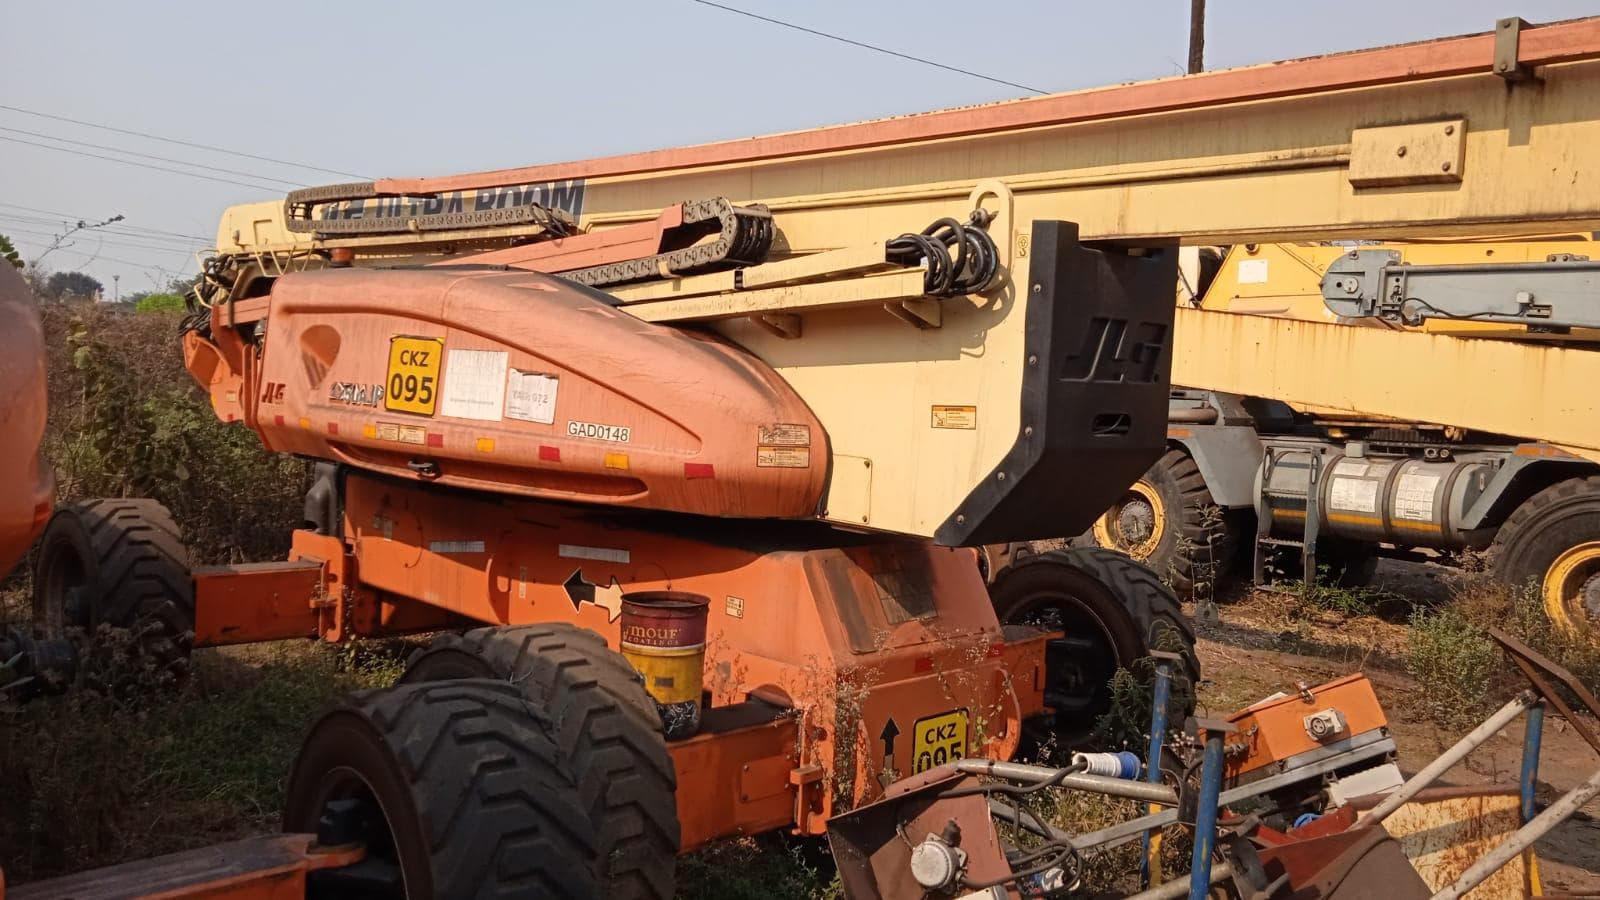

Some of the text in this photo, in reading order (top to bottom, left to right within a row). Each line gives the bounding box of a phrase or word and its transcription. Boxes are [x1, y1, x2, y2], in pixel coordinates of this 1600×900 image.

[400, 350, 430, 367] CKZ
[390, 373, 433, 404] 095
[568, 422, 628, 441] GAD0148
[925, 722, 957, 745] CKZ
